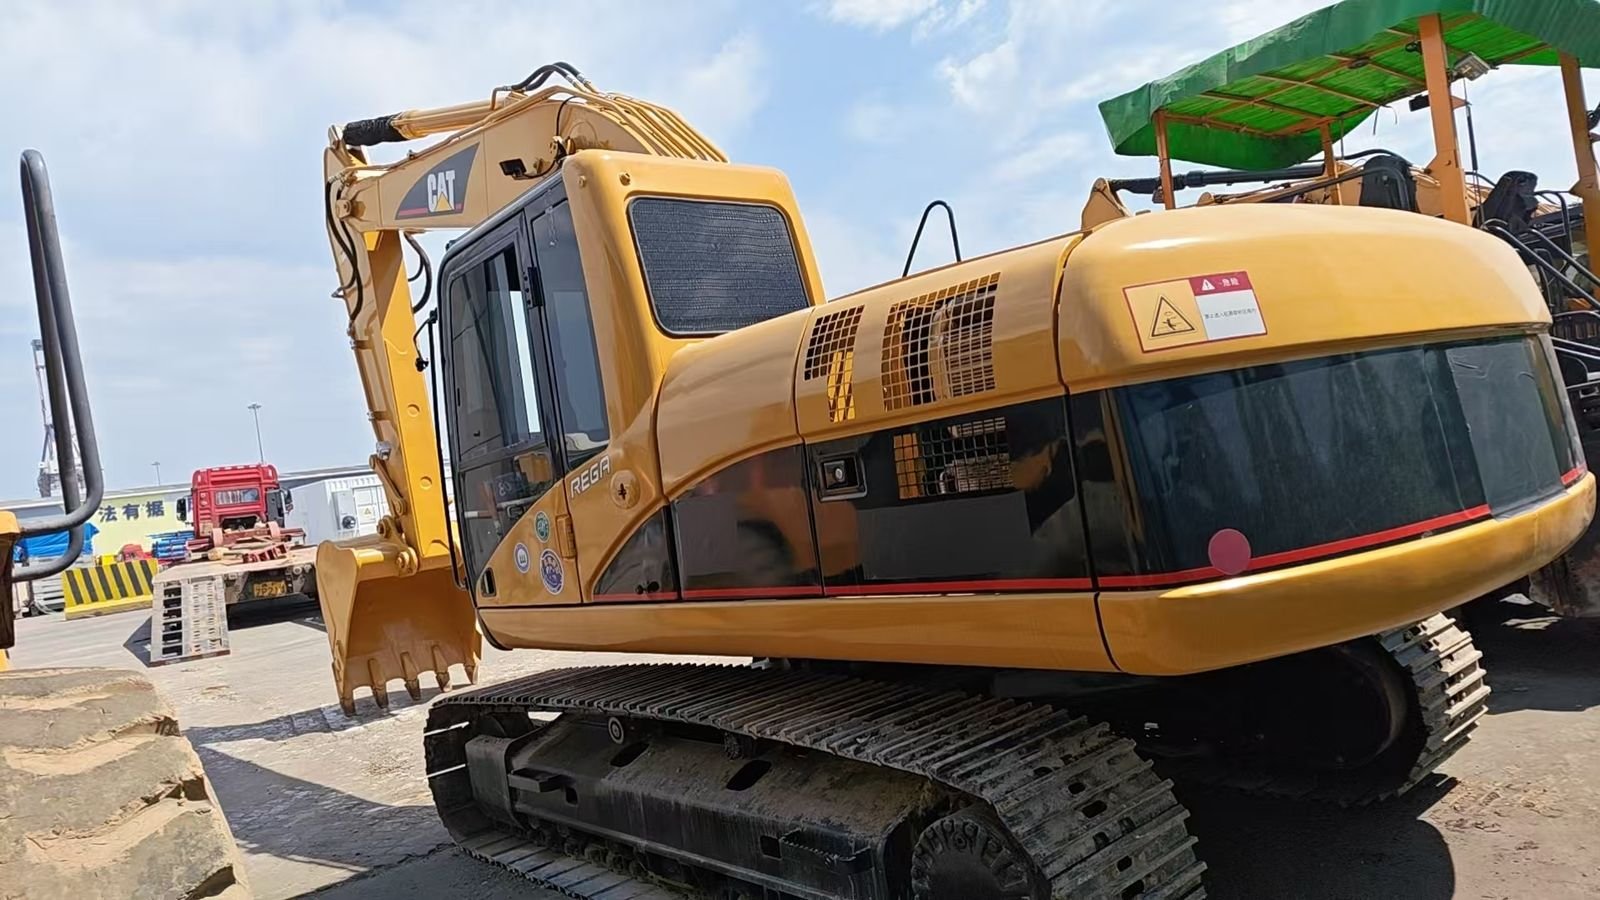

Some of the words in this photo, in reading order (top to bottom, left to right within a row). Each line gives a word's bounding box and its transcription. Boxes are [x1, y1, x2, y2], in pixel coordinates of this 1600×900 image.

[427, 170, 456, 213] CAT
[570, 455, 610, 498] REGA
[98, 500, 165, 523] 法有据
